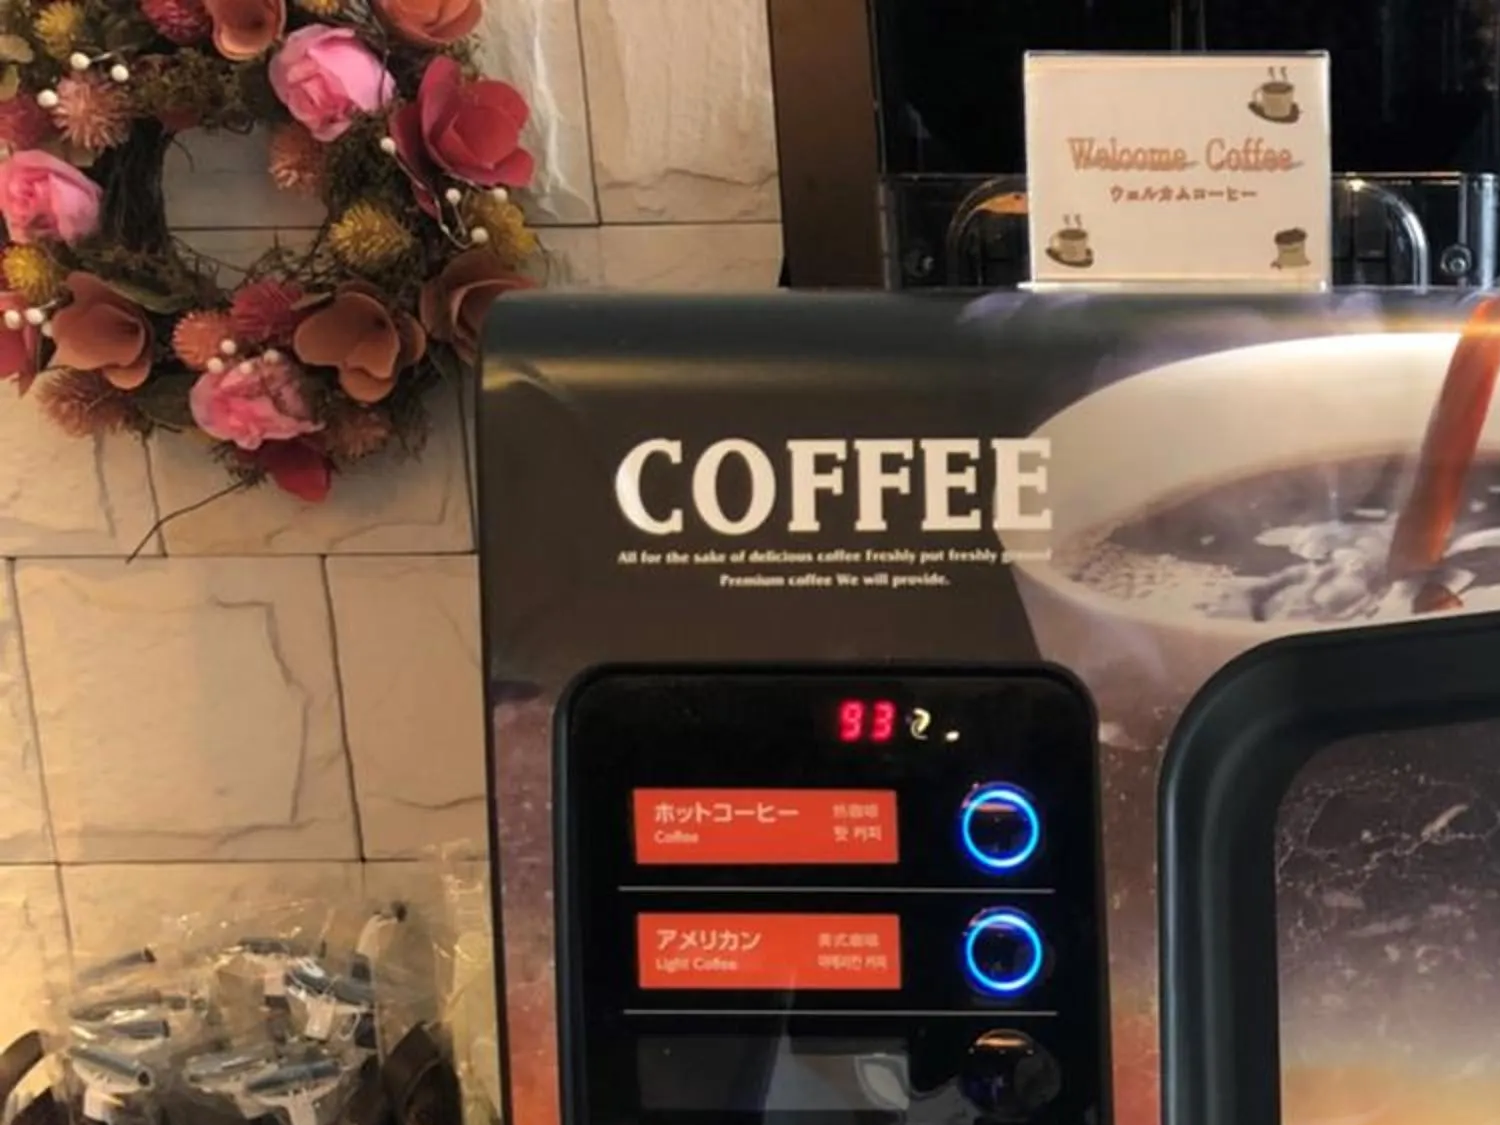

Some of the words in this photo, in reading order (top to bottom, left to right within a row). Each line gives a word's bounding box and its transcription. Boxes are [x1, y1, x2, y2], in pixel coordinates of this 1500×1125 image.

[1067, 137, 1191, 172] Welcome
[1205, 137, 1296, 172] Coffee
[1109, 186, 1258, 201] ウェルカムコーヒー
[615, 437, 1053, 535] COFFEE
[617, 550, 638, 564] All
[641, 550, 662, 564] for
[665, 550, 689, 564] the
[694, 550, 726, 564] sake
[730, 550, 746, 564] of
[749, 550, 813, 563] delicious
[817, 549, 861, 563] coffee
[920, 550, 944, 564] put
[948, 548, 997, 564] freshly
[719, 573, 785, 587] Premium
[788, 573, 833, 587] coffee
[836, 572, 860, 586] We
[863, 572, 889, 586] will
[892, 571, 951, 588] provide.
[838, 701, 896, 742] 93
[655, 801, 799, 824] ホットコーヒー
[654, 830, 699, 844] Coffee
[655, 929, 762, 951] アメリカン
[655, 957, 689, 973] Light
[693, 957, 738, 971] Coffee
